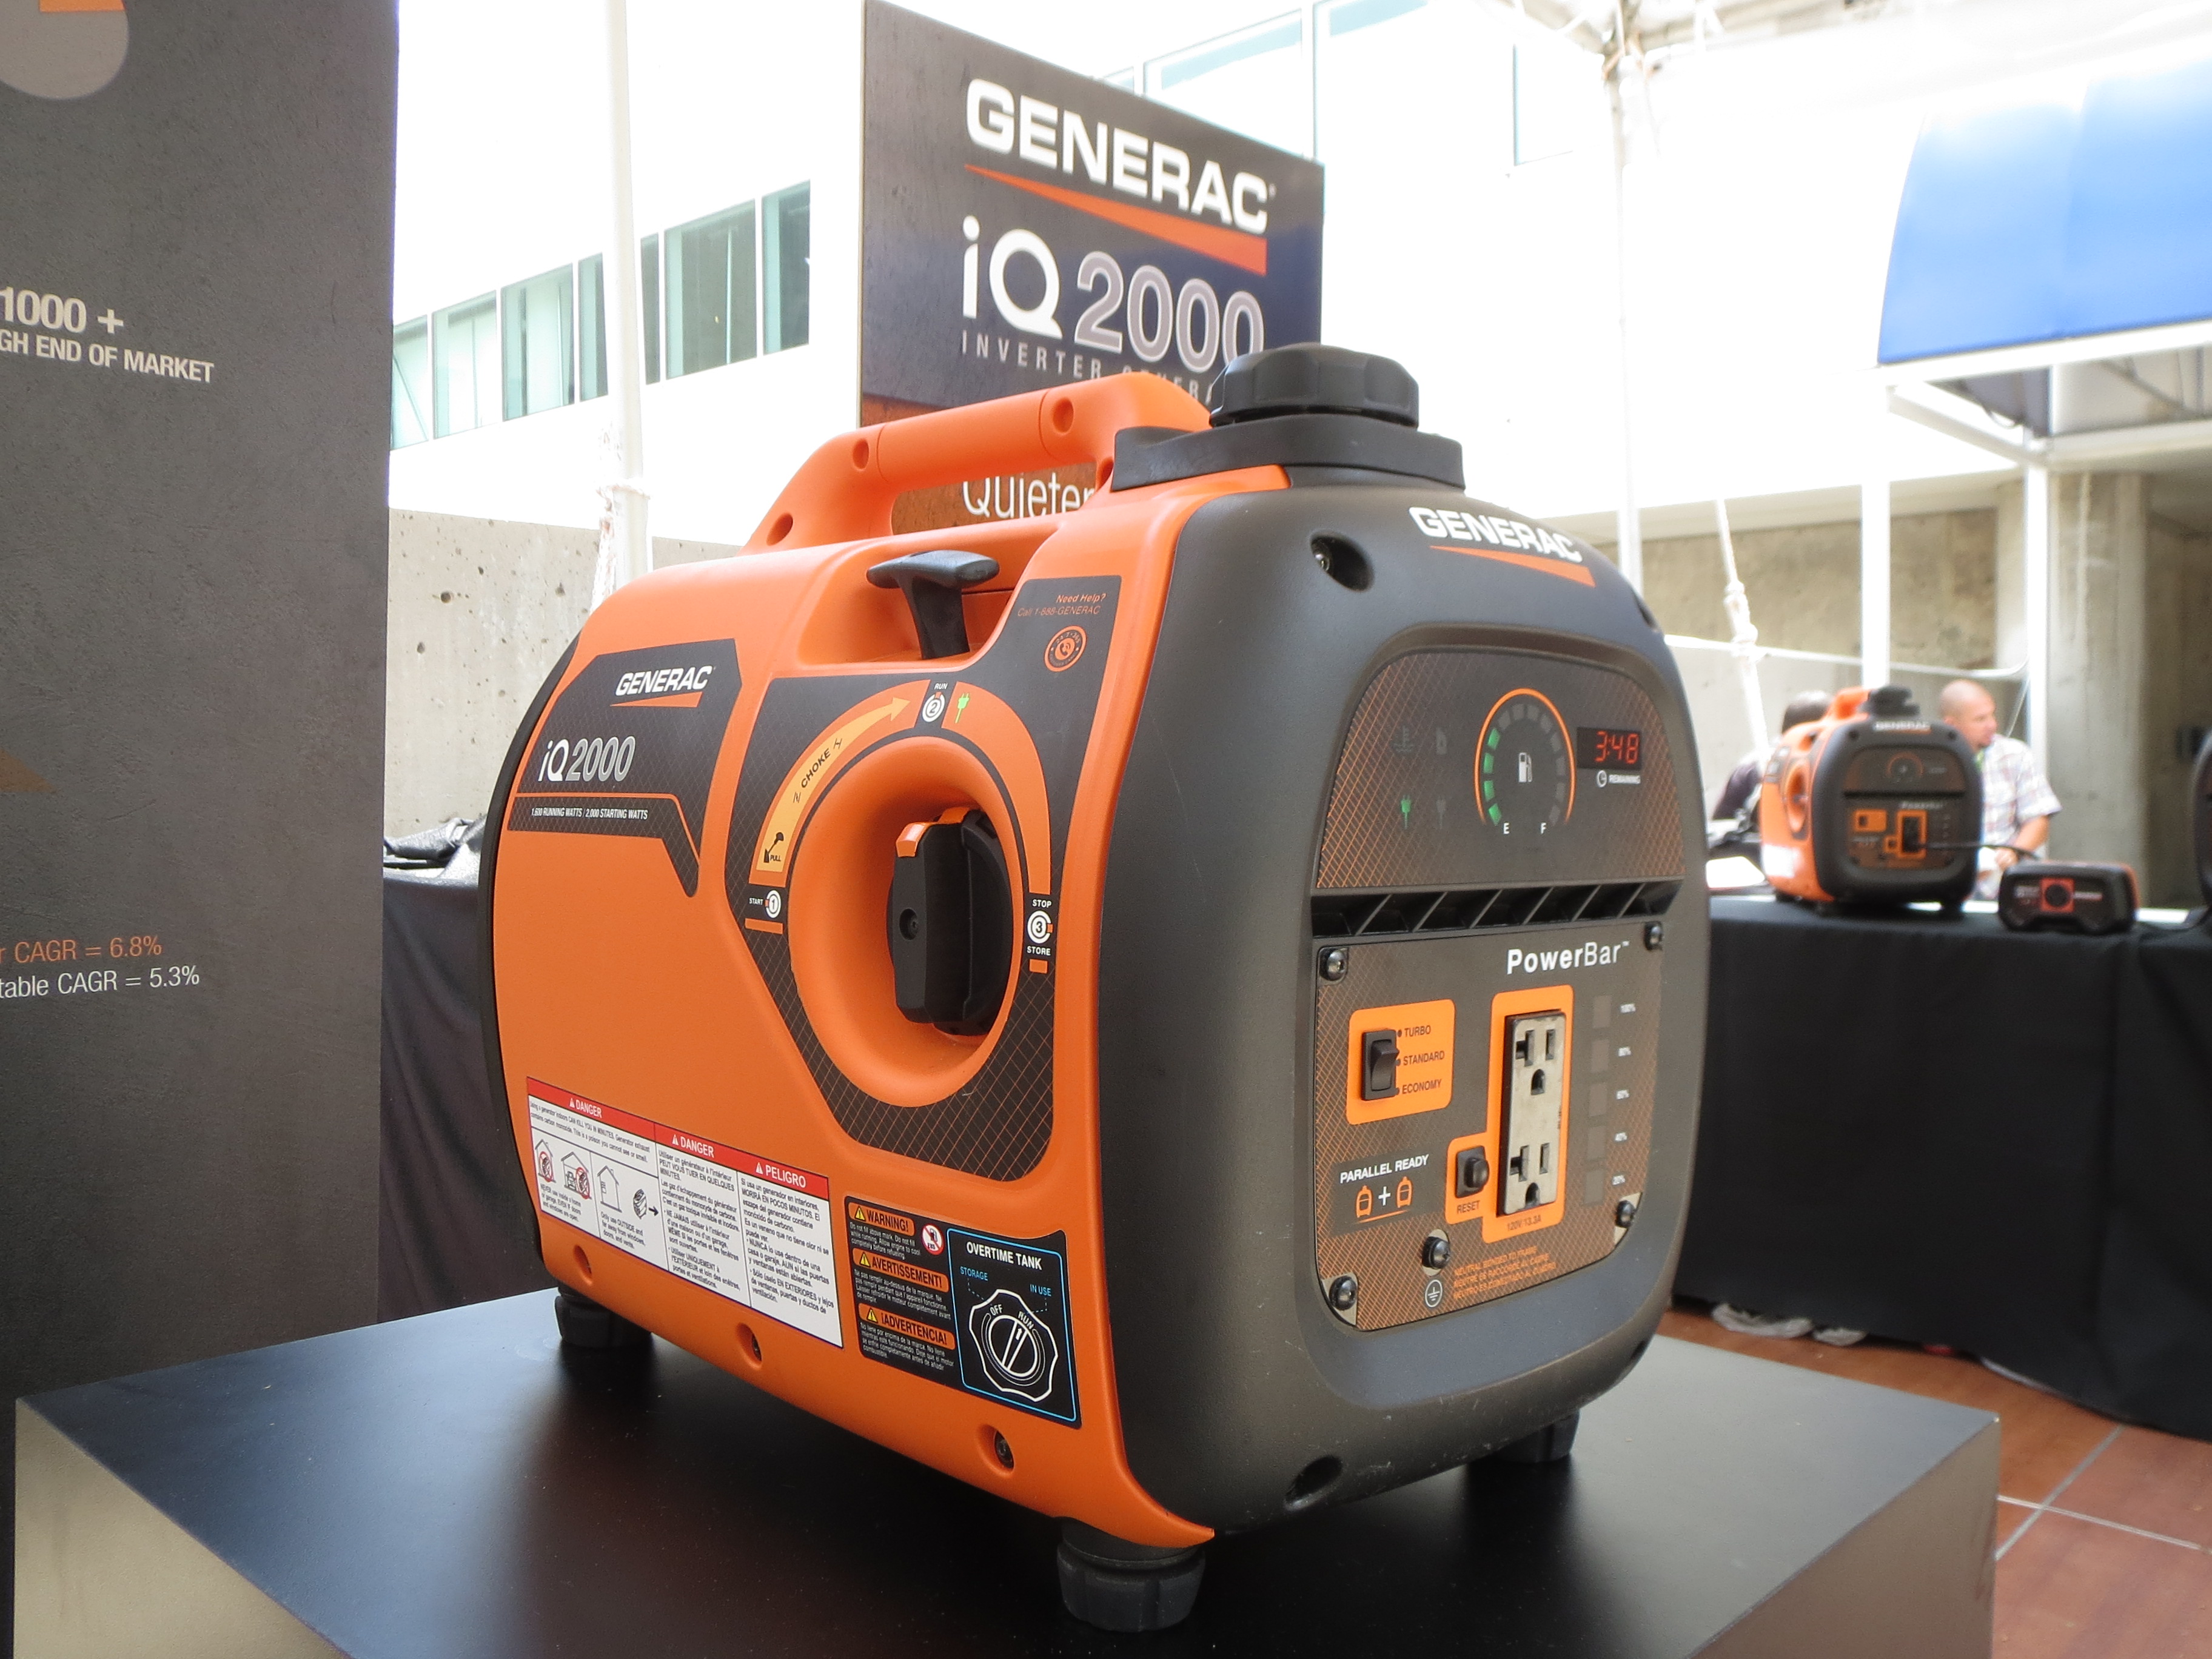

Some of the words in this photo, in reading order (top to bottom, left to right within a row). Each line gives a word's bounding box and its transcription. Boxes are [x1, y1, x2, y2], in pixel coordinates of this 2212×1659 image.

[967, 78, 1267, 235] GENERAC
[0, 286, 87, 333] 1000
[97, 309, 124, 334] +
[0, 329, 29, 355] GH
[36, 334, 82, 362] END
[89, 343, 118, 368] OF
[124, 349, 215, 383] MARKET
[962, 330, 1102, 379] INVERTER
[1409, 506, 1583, 563] GENERAC
[1056, 594, 1079, 603] Need
[1079, 593, 1107, 604] Help?
[1017, 608, 1032, 617] Call
[615, 665, 713, 697] GENERAC
[801, 748, 831, 788] CHOKE
[565, 807, 583, 817] WATTS
[599, 808, 627, 819] STARTING
[628, 809, 648, 820] WATTS
[1503, 822, 1510, 834] E
[1540, 822, 1547, 834] F
[1032, 899, 1052, 908] STOP
[15, 939, 77, 963] CAGR
[85, 946, 101, 956] =
[110, 935, 163, 958] 6.8%
[1027, 946, 1051, 956] STORE
[0, 975, 49, 999] table
[58, 970, 118, 994] CAGR
[125, 977, 141, 987] =
[150, 965, 200, 988] 5.3%
[1404, 1025, 1432, 1037] TURBO
[1403, 1050, 1445, 1066] STANDARD
[1402, 1078, 1442, 1094] ECONOMY
[575, 1099, 603, 1119] DANGER
[680, 1136, 714, 1158] DANGER
[765, 1164, 807, 1188] PELIGRO
[1340, 1162, 1392, 1184] PARALLEL
[1395, 1154, 1429, 1171] READY
[1456, 1201, 1481, 1214] RESET
[866, 1209, 909, 1233] WARNING!
[967, 1241, 1014, 1264] OVERTIME
[1016, 1252, 1042, 1270] TANK
[872, 1256, 942, 1288] AVERTISSEMENT!
[960, 1266, 988, 1281] STORAGE
[1030, 1284, 1037, 1293] IN
[1038, 1286, 1052, 1297] USE
[990, 1304, 1003, 1316] OFF
[1018, 1311, 1034, 1330] RUN
[881, 1313, 947, 1346] ¡ADVERTENCIA!
